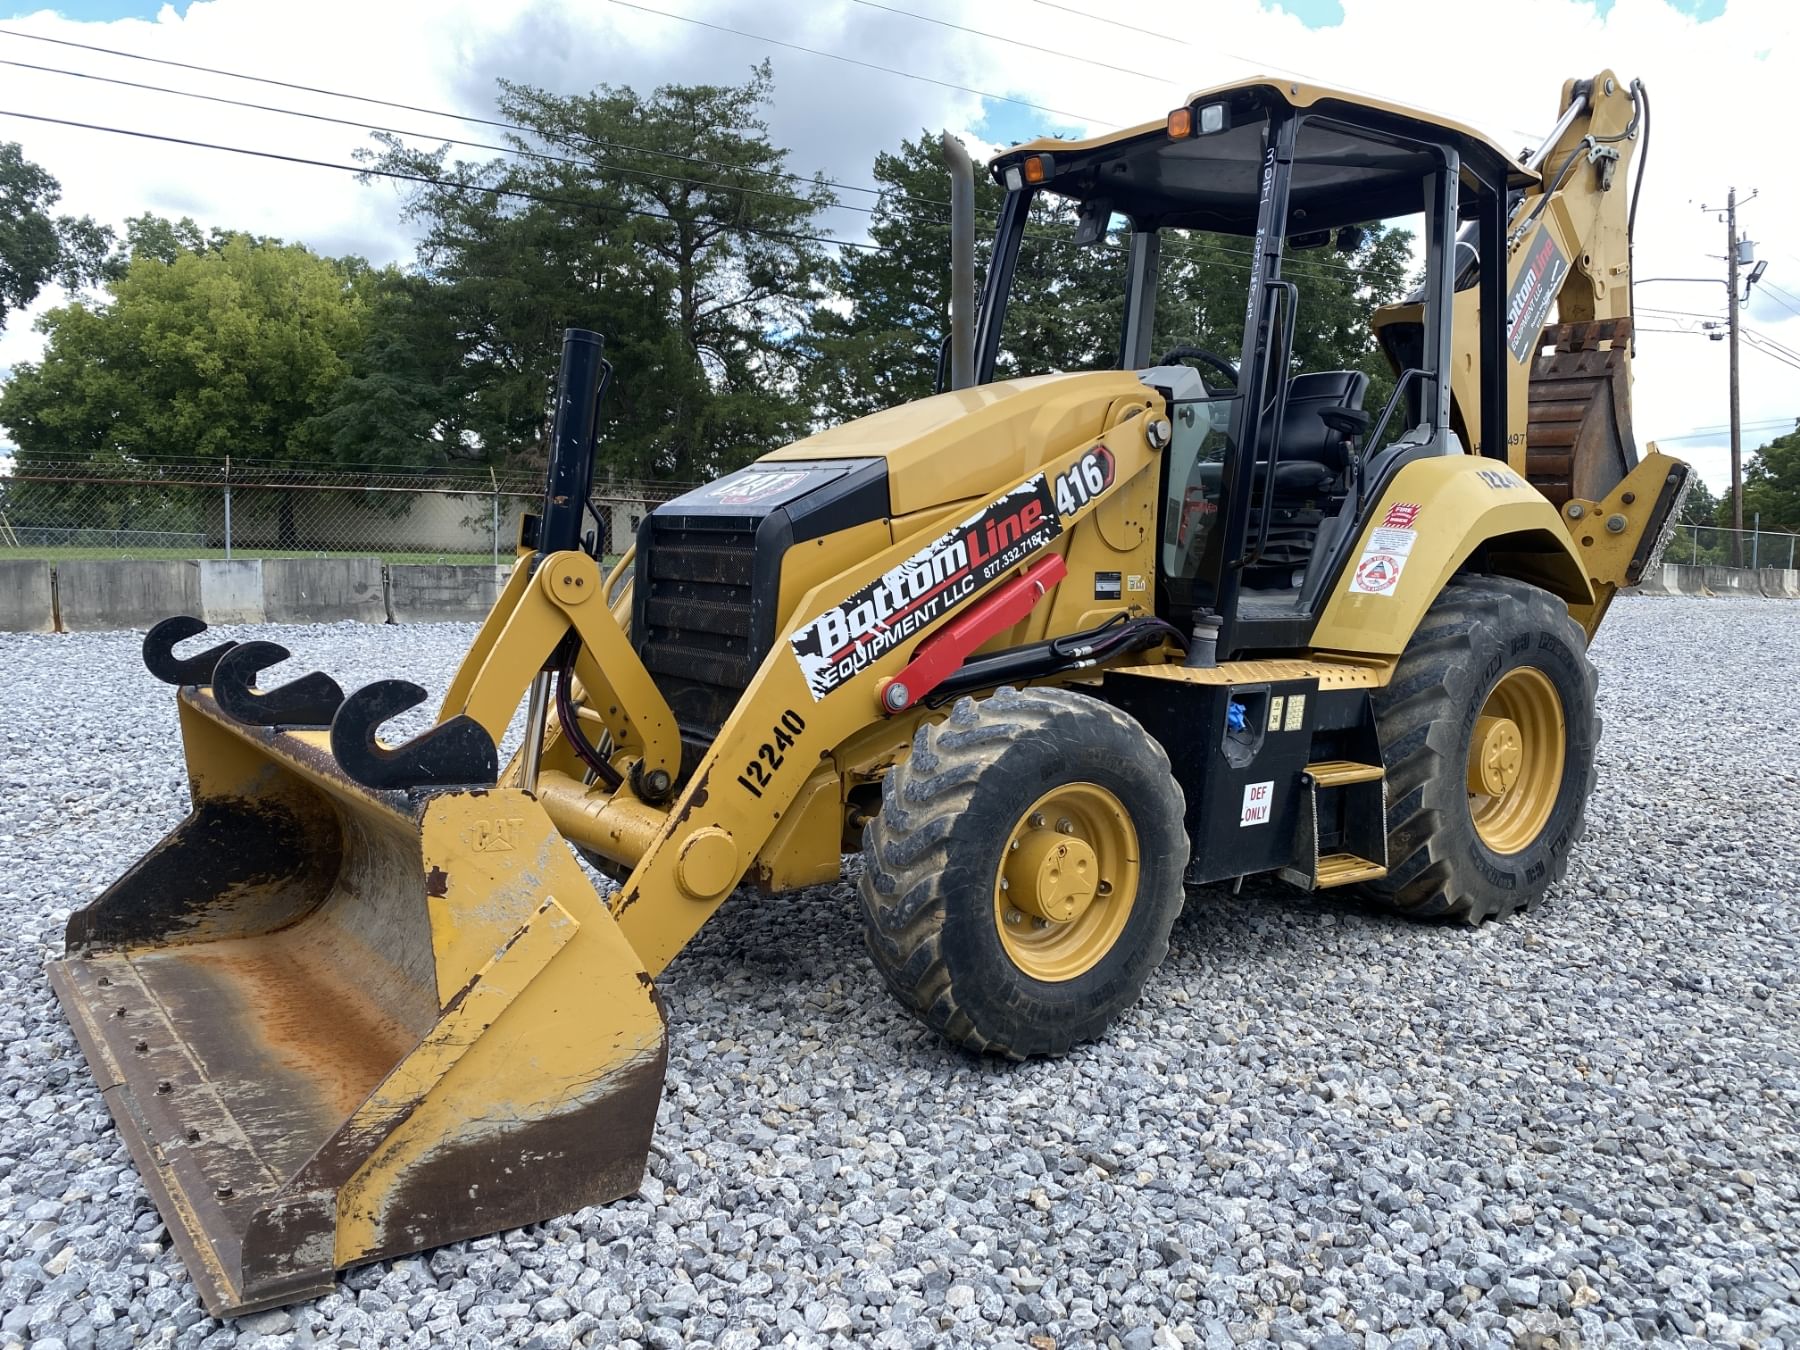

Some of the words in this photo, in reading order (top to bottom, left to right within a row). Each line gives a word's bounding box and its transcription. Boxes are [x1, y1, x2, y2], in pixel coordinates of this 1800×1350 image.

[1055, 453, 1104, 516] 416
[816, 498, 1044, 658] BottomLine
[983, 530, 1044, 579] 877.332.7187
[825, 596, 941, 688] EQUIPMENT
[944, 576, 975, 605] LLC
[737, 709, 806, 798] 12240
[1245, 806, 1267, 822] ONLY
[1250, 786, 1267, 801] DEF
[472, 819, 524, 852] CAT
